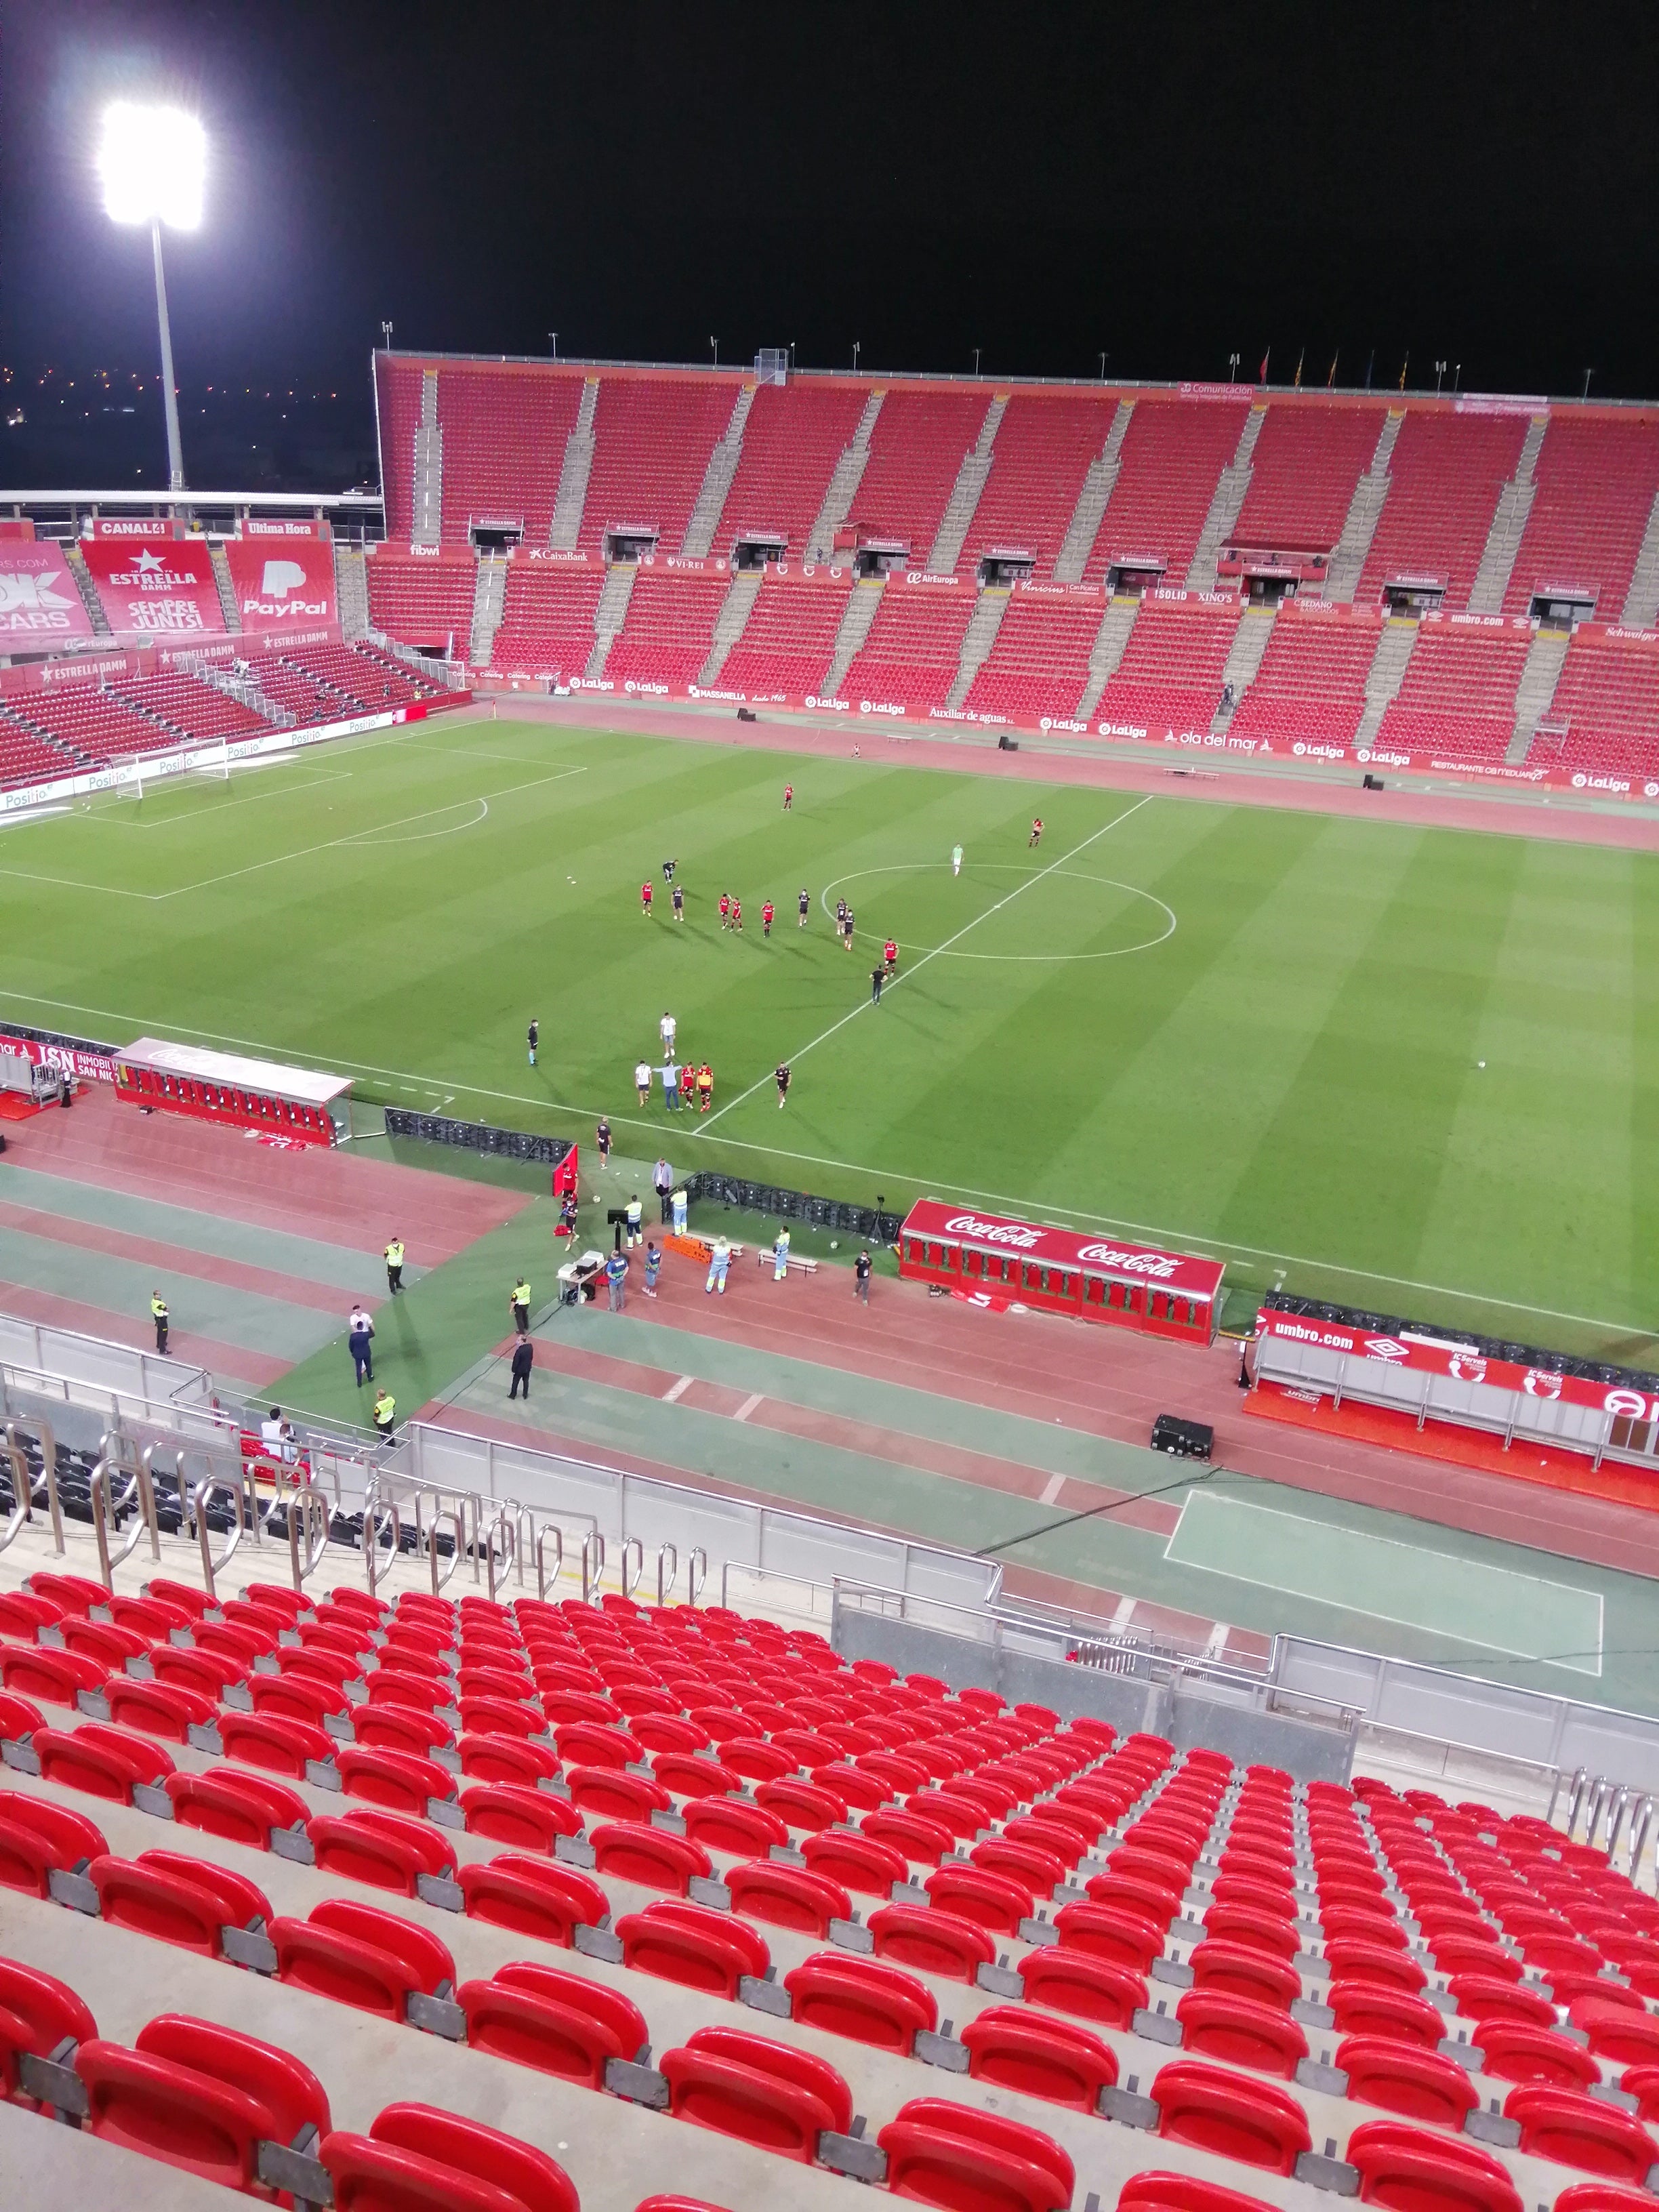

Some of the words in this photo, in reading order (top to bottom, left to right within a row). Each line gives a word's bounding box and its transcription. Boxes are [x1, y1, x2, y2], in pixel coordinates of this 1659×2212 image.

[1193, 384, 1252, 394] Comunicación
[285, 523, 312, 535] Hora
[410, 544, 440, 556] fibwi
[542, 550, 588, 562] CaixaBank
[109, 573, 198, 585] ESTRELLA
[922, 575, 959, 585] AirEuropa
[1198, 592, 1233, 603] XINO'S
[128, 599, 200, 617] SEMPRE
[243, 600, 327, 617] PayPal
[133, 613, 205, 630] JUNTS!
[1452, 613, 1504, 626] umbro.com
[274, 634, 306, 648] ESTRELLA
[307, 631, 328, 643] DAMM
[211, 644, 234, 657] DAMM
[55, 663, 98, 679] ESTRELLA
[99, 659, 127, 672] DAMM
[582, 678, 614, 691] LaLiga
[637, 682, 669, 695] LaLiga
[700, 689, 746, 701] MASSANELLA
[752, 694, 769, 702] desde
[770, 694, 787, 702] 1965
[817, 698, 849, 710] LaLiga
[872, 703, 905, 715] LaLiga
[929, 707, 967, 720] Auxiliar
[967, 710, 978, 721] de
[979, 713, 1007, 724] aguas
[1052, 719, 1088, 733] LaLiga
[1111, 724, 1147, 739] LaLiga
[1181, 731, 1202, 744] ola
[1204, 733, 1227, 747] del
[1229, 738, 1258, 750] mar
[1307, 743, 1345, 758] LaLiga
[1371, 751, 1410, 766] LaLiga
[1431, 760, 1484, 774] RESTAURANTE
[1588, 777, 1631, 792] LaLiga
[78, 1065, 96, 1078] SAN
[1275, 1322, 1353, 1350] umbro.com
